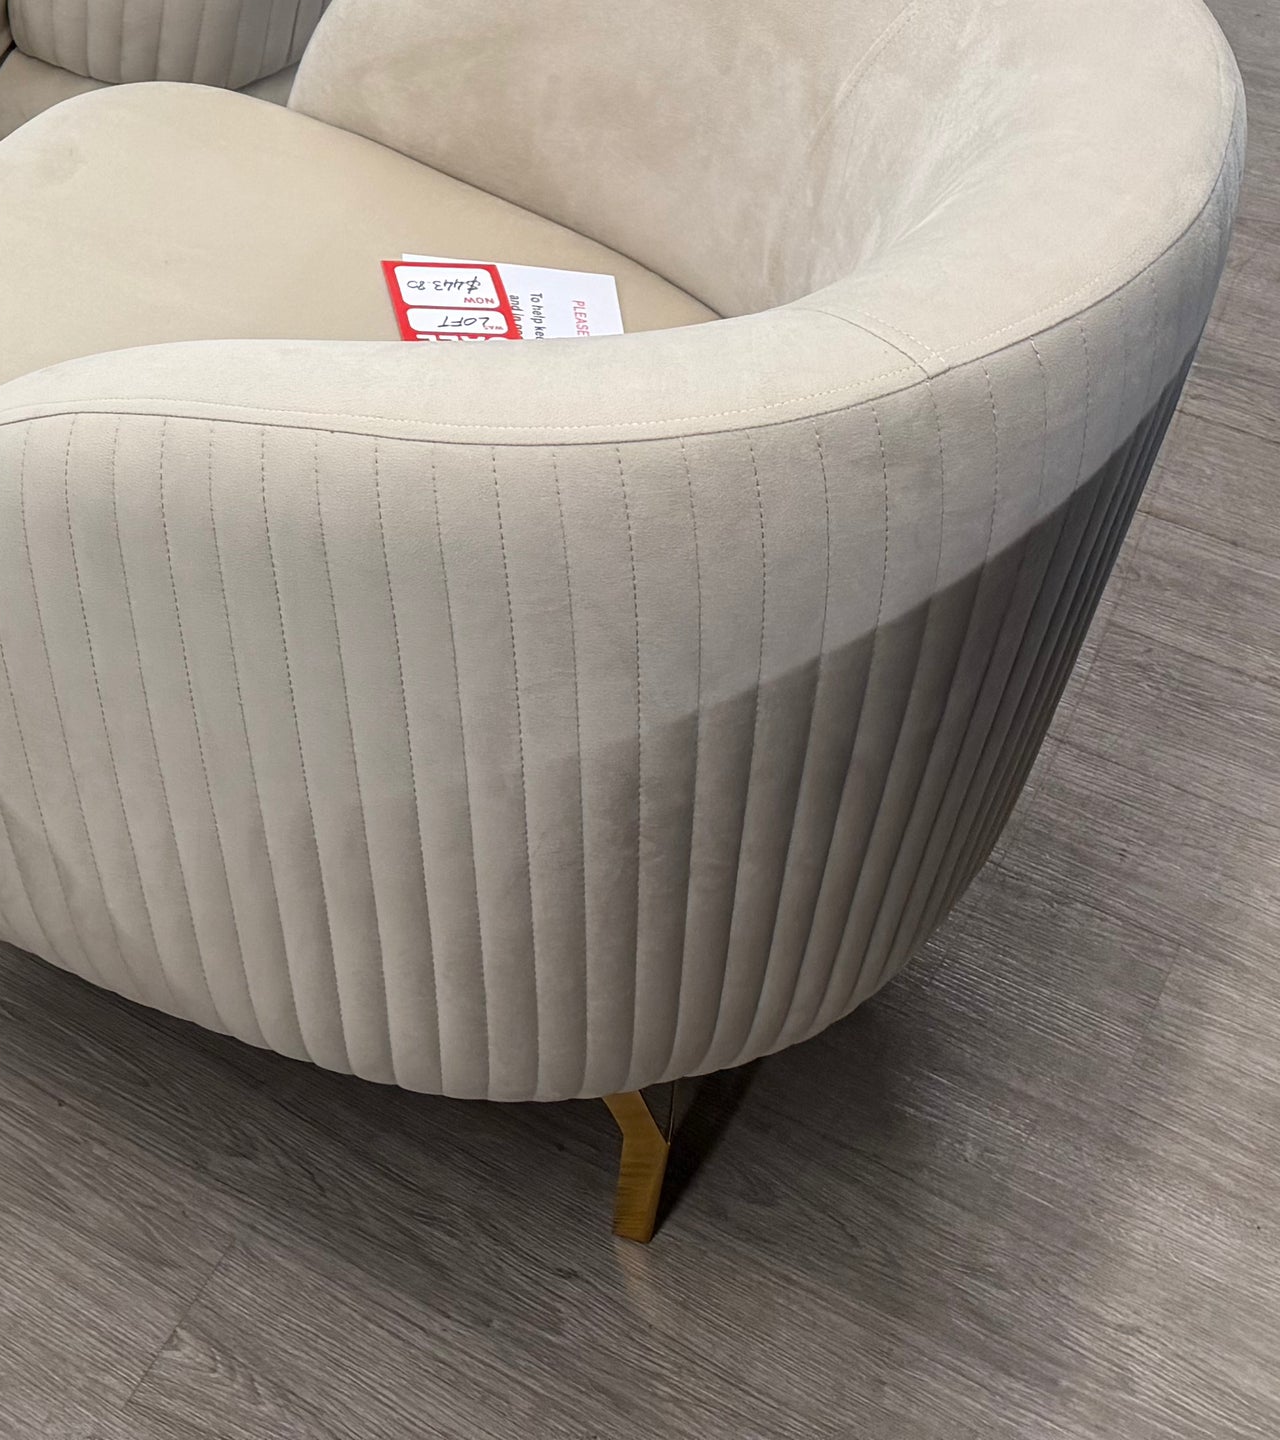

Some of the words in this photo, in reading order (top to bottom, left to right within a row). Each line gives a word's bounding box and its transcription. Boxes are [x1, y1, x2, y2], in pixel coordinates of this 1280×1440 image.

[509, 294, 524, 312] and
[530, 293, 543, 303] To
[530, 305, 546, 324] help
[572, 300, 590, 337] PLEASE
